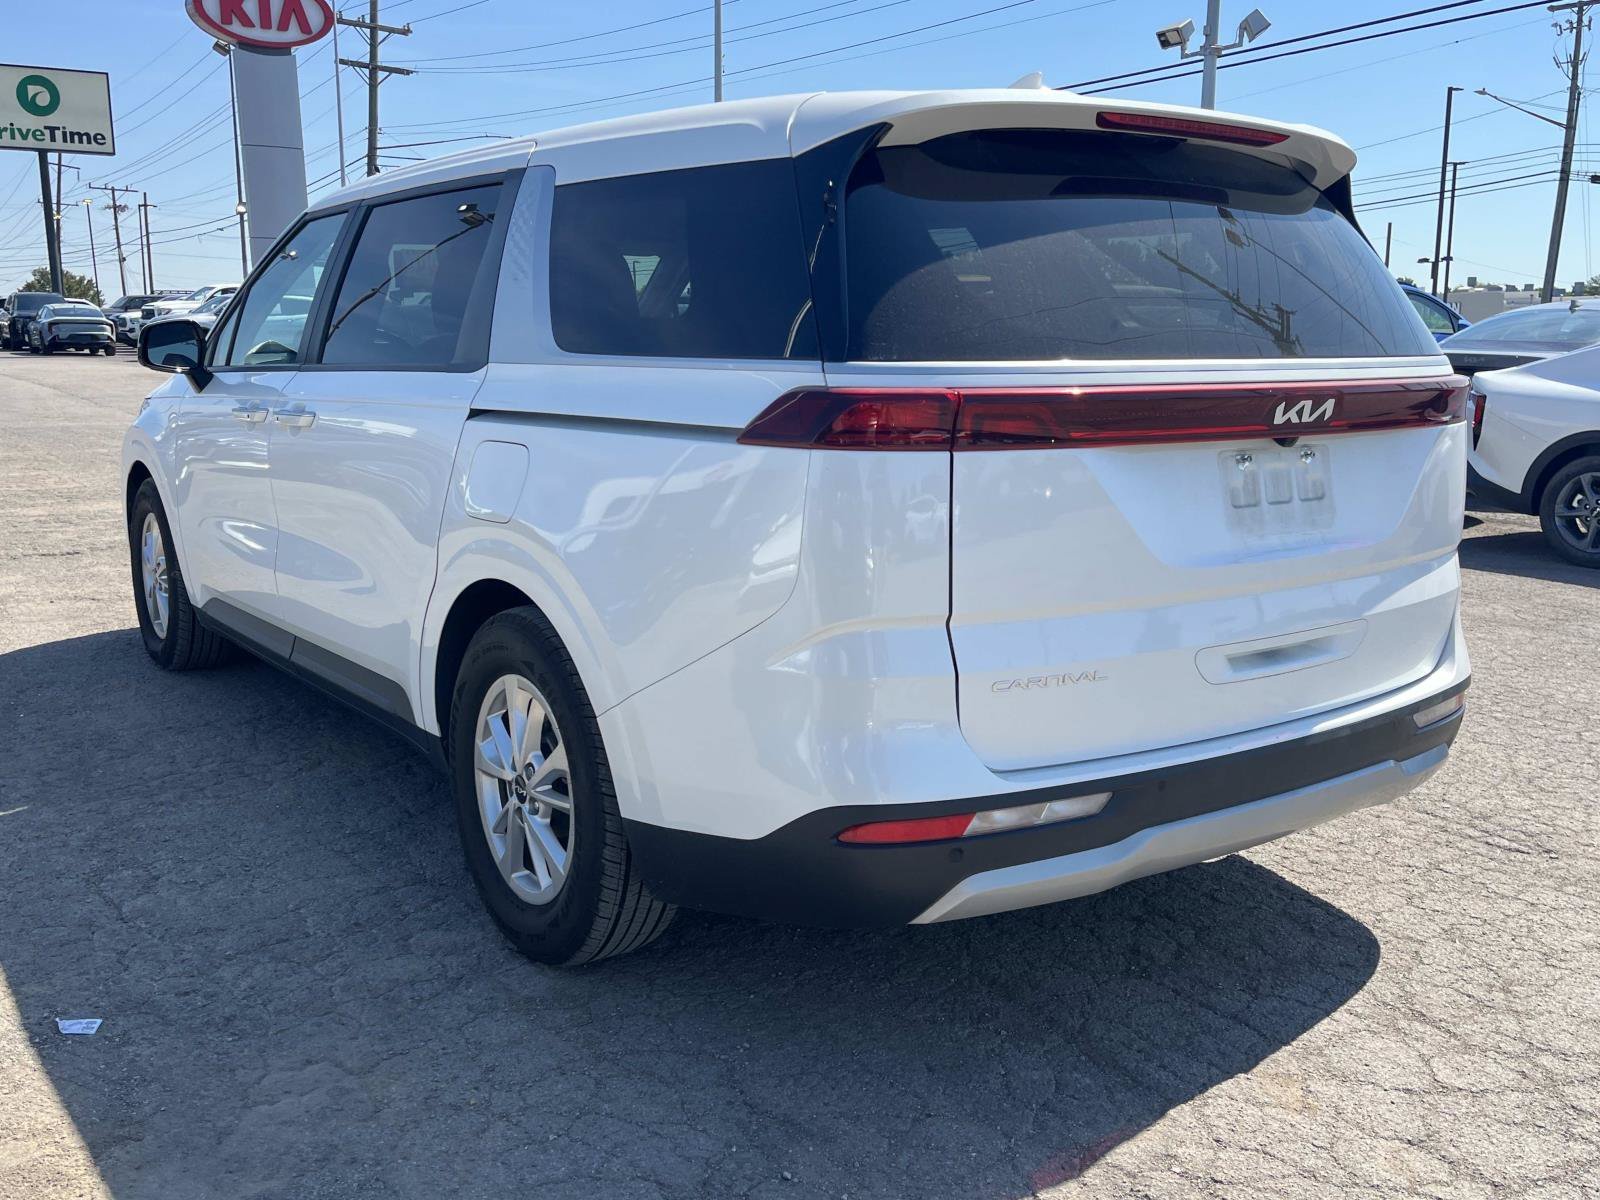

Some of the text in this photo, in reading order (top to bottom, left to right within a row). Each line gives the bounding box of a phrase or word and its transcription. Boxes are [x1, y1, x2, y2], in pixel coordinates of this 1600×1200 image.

[220, 0, 313, 35] KIA
[1273, 398, 1335, 425] KIA
[991, 670, 1108, 693] CARNIVAL
